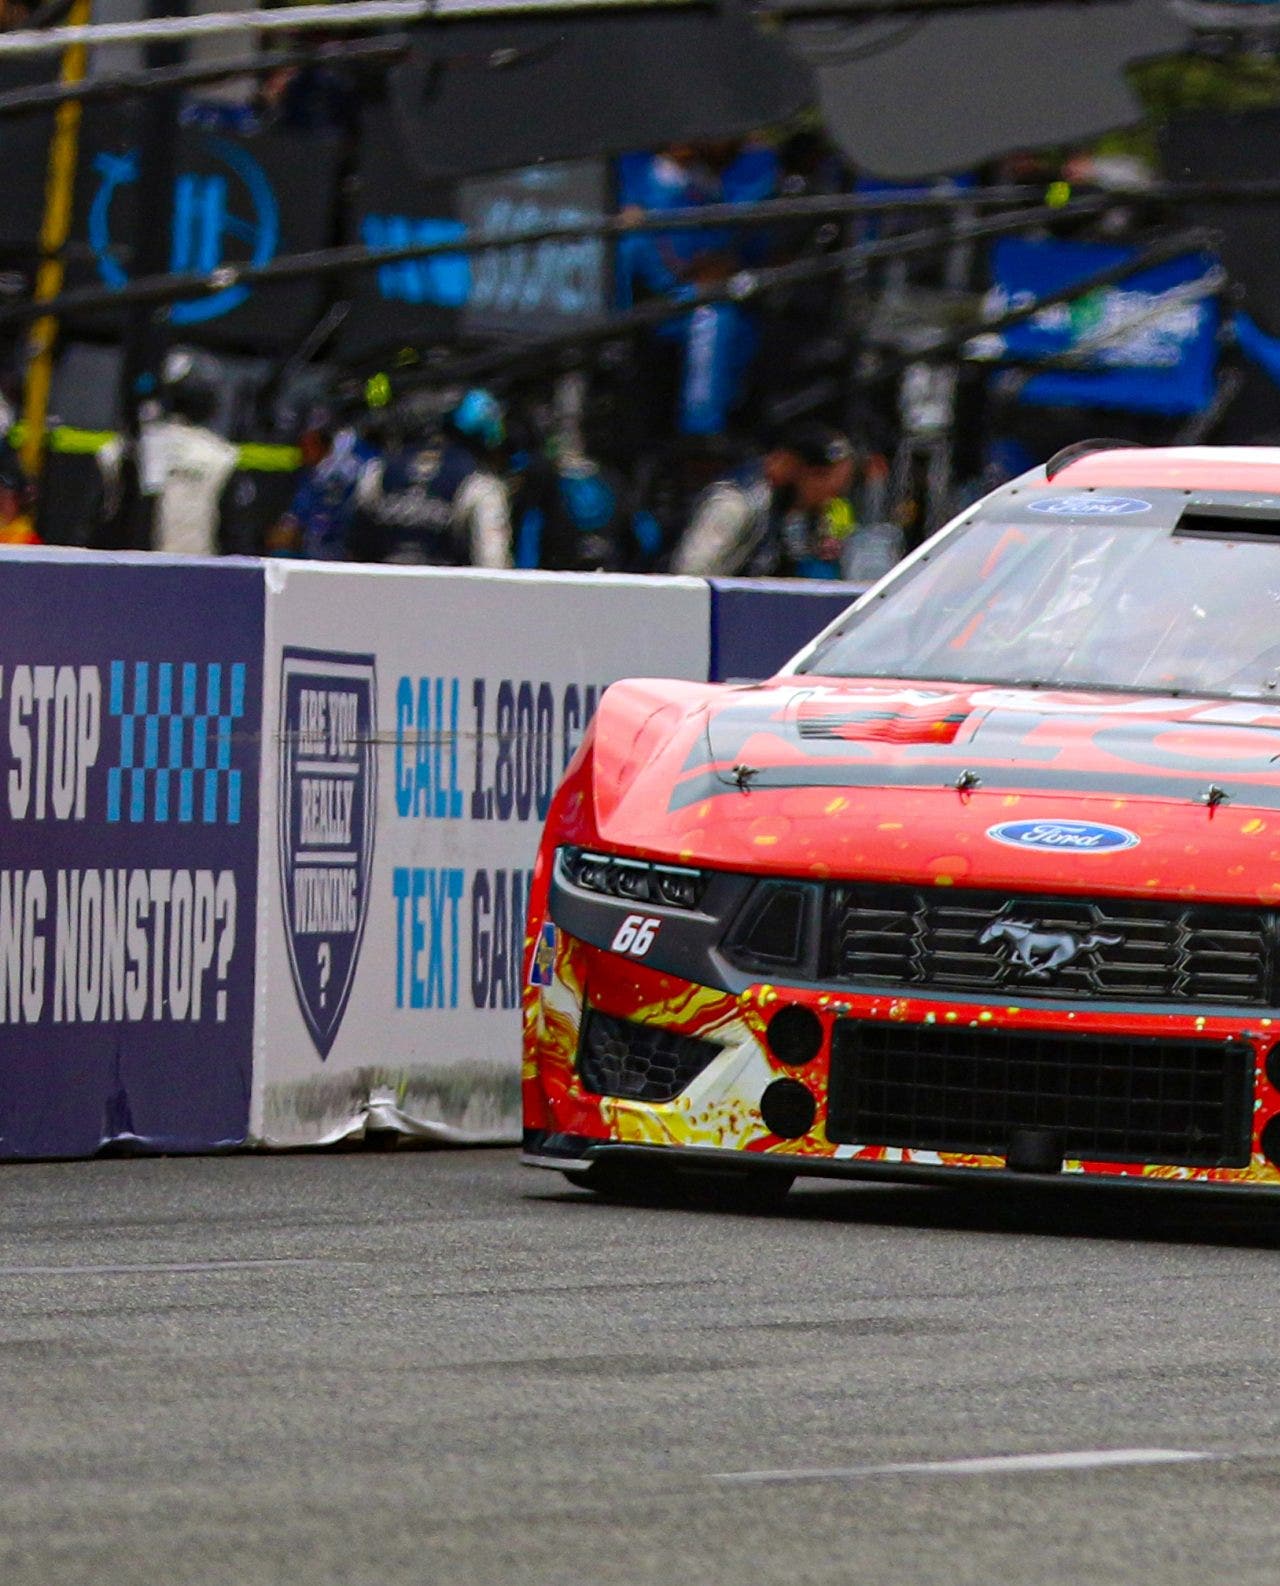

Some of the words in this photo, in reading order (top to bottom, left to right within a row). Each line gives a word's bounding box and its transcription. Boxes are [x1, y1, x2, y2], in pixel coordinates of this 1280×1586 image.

[9, 664, 101, 820] STOP
[300, 777, 355, 845] REALLY
[394, 676, 463, 819] CALL
[53, 868, 237, 1024] NONSTOP?
[393, 866, 464, 1009] TEXT
[611, 914, 661, 956] 66
